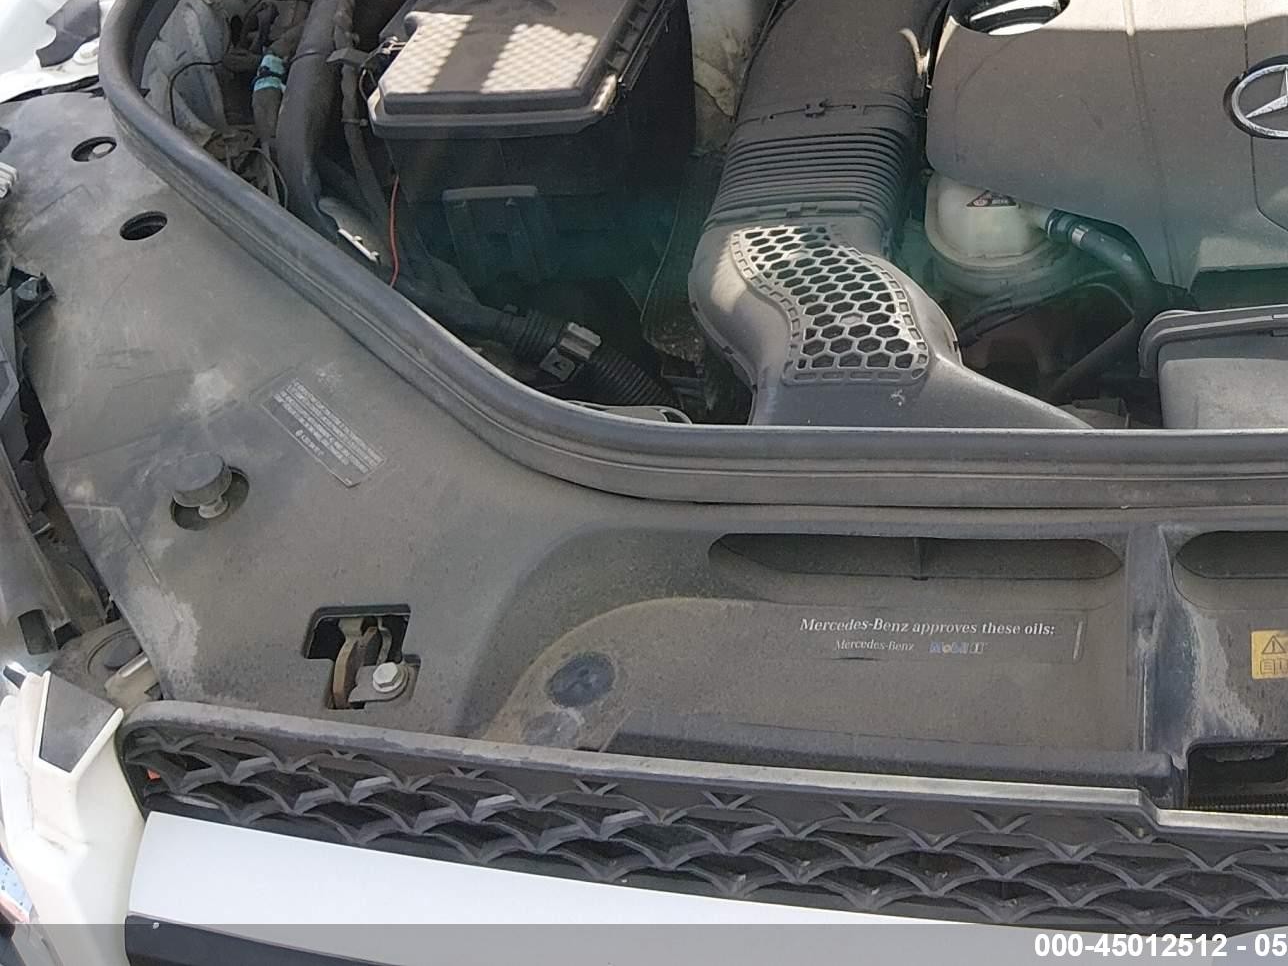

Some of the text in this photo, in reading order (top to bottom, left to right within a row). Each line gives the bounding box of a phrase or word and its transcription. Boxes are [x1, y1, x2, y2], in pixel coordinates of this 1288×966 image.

[799, 618, 1056, 636] Mercedes-Benz approves these oils:
[834, 639, 915, 652] Mercedes-Benz
